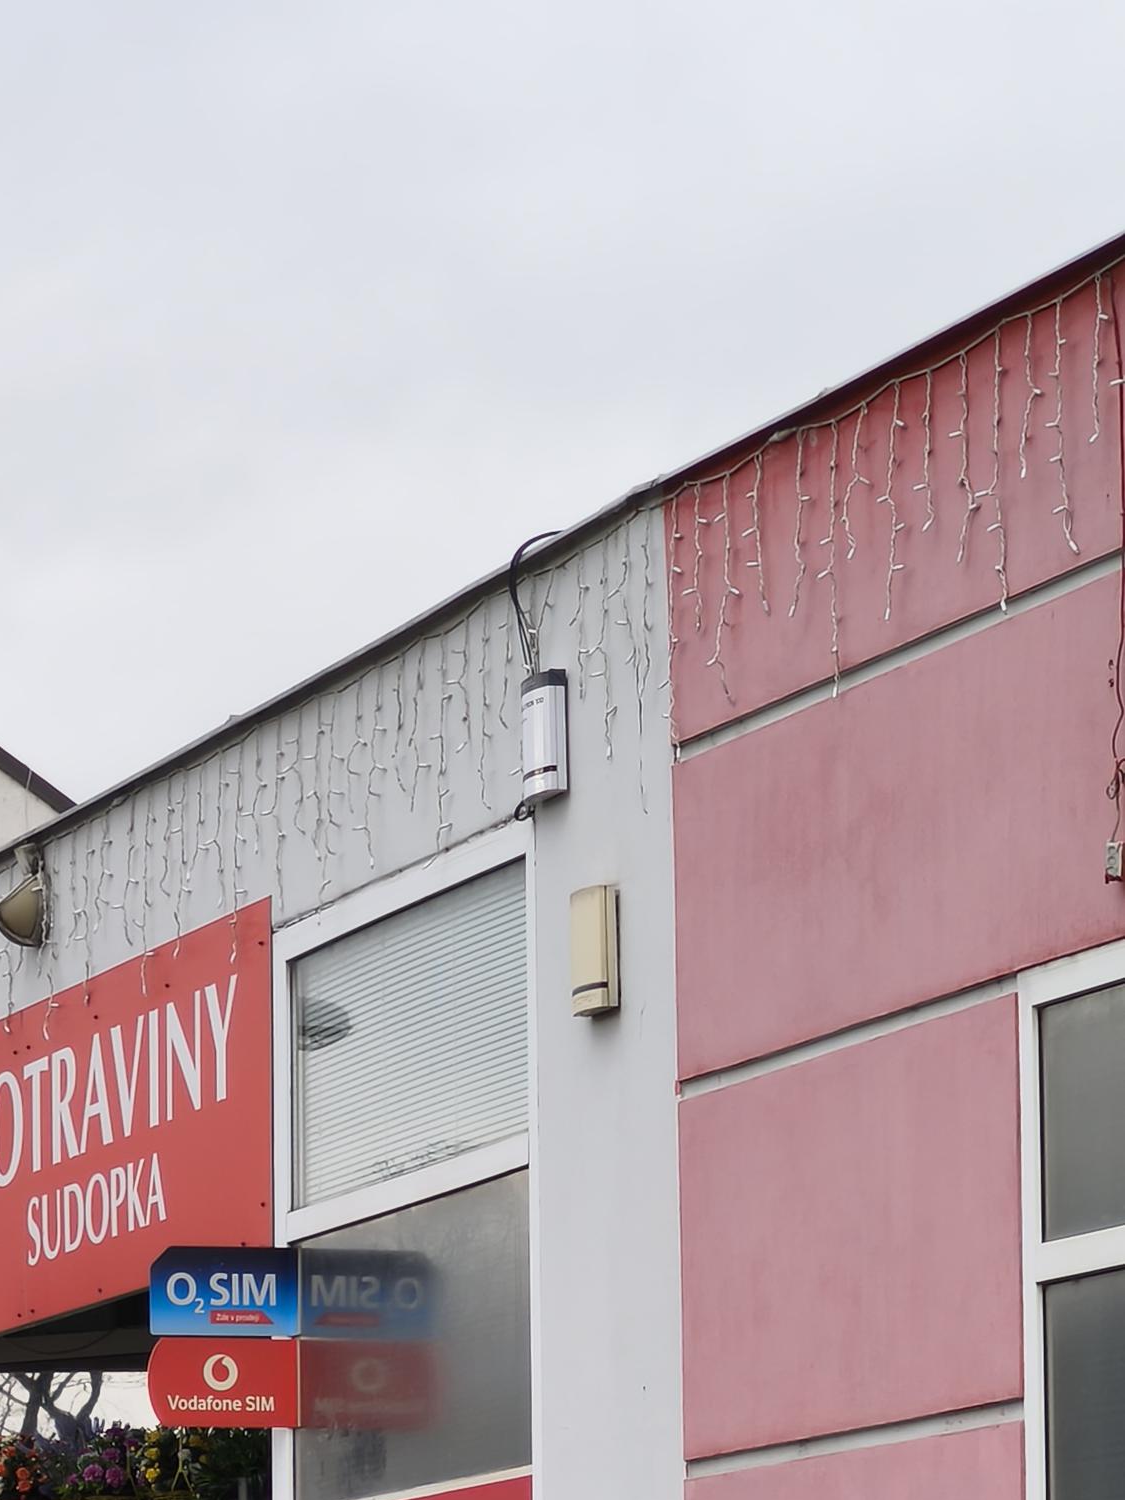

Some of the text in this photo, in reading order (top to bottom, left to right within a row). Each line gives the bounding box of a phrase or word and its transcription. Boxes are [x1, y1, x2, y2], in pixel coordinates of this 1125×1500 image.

[27, 1152, 167, 1266] SUDOPKA
[209, 1272, 277, 1306] SIM
[167, 1395, 275, 1412] Vodafone SIM
